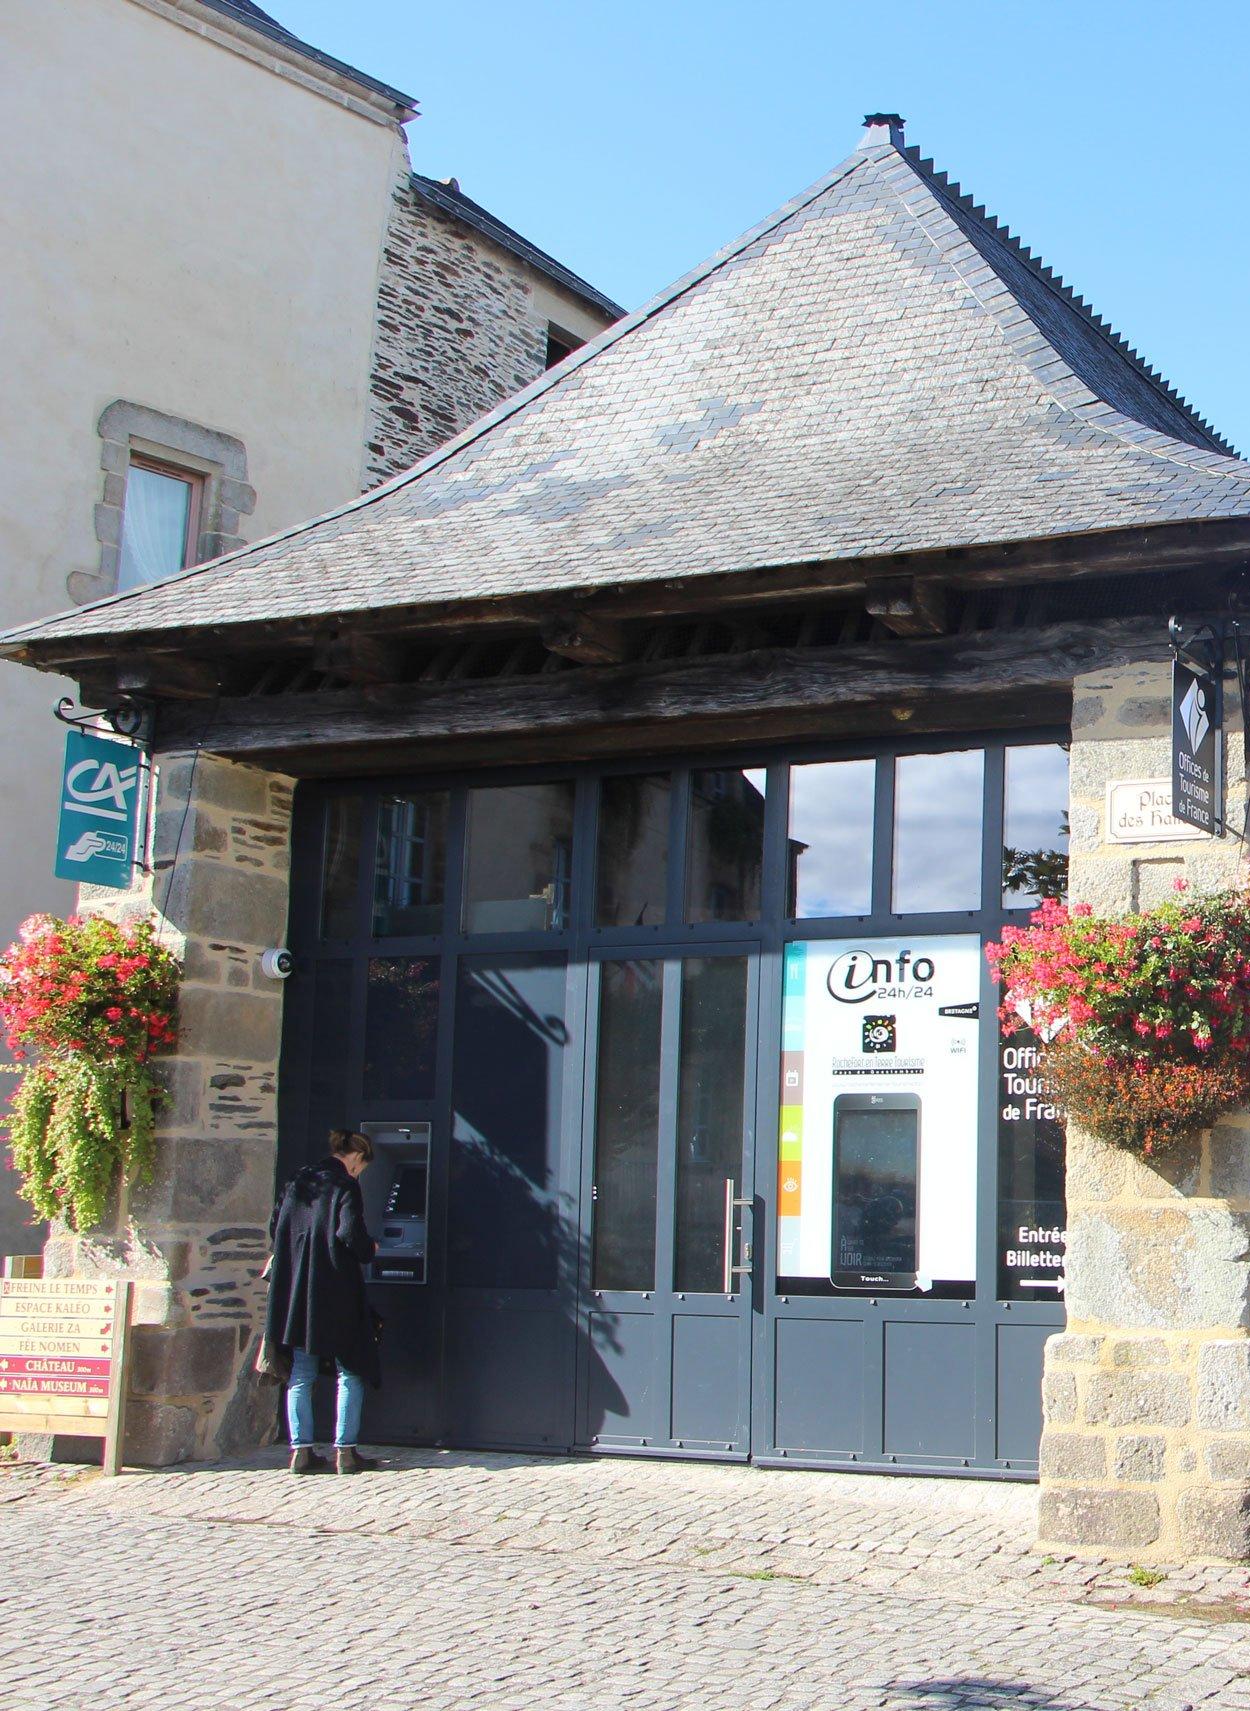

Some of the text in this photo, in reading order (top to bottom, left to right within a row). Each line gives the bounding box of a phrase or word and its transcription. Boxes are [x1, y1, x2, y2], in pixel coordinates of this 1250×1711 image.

[1179, 751, 1202, 779] Offices
[1179, 772, 1209, 804] Tourisme
[1139, 790, 1172, 812] Plac
[1179, 800, 1186, 814] de
[1186, 798, 1209, 825] France
[878, 987, 933, 1000] 24h/24
[1003, 1104, 1020, 1120] de
[64, 1284, 98, 1295] TEMPS
[15, 1302, 54, 1313] ESPACE
[21, 1321, 64, 1333] GALERIE
[25, 1359, 76, 1372] CHÂTEAU
[41, 1381, 87, 1393] MUSEUM
